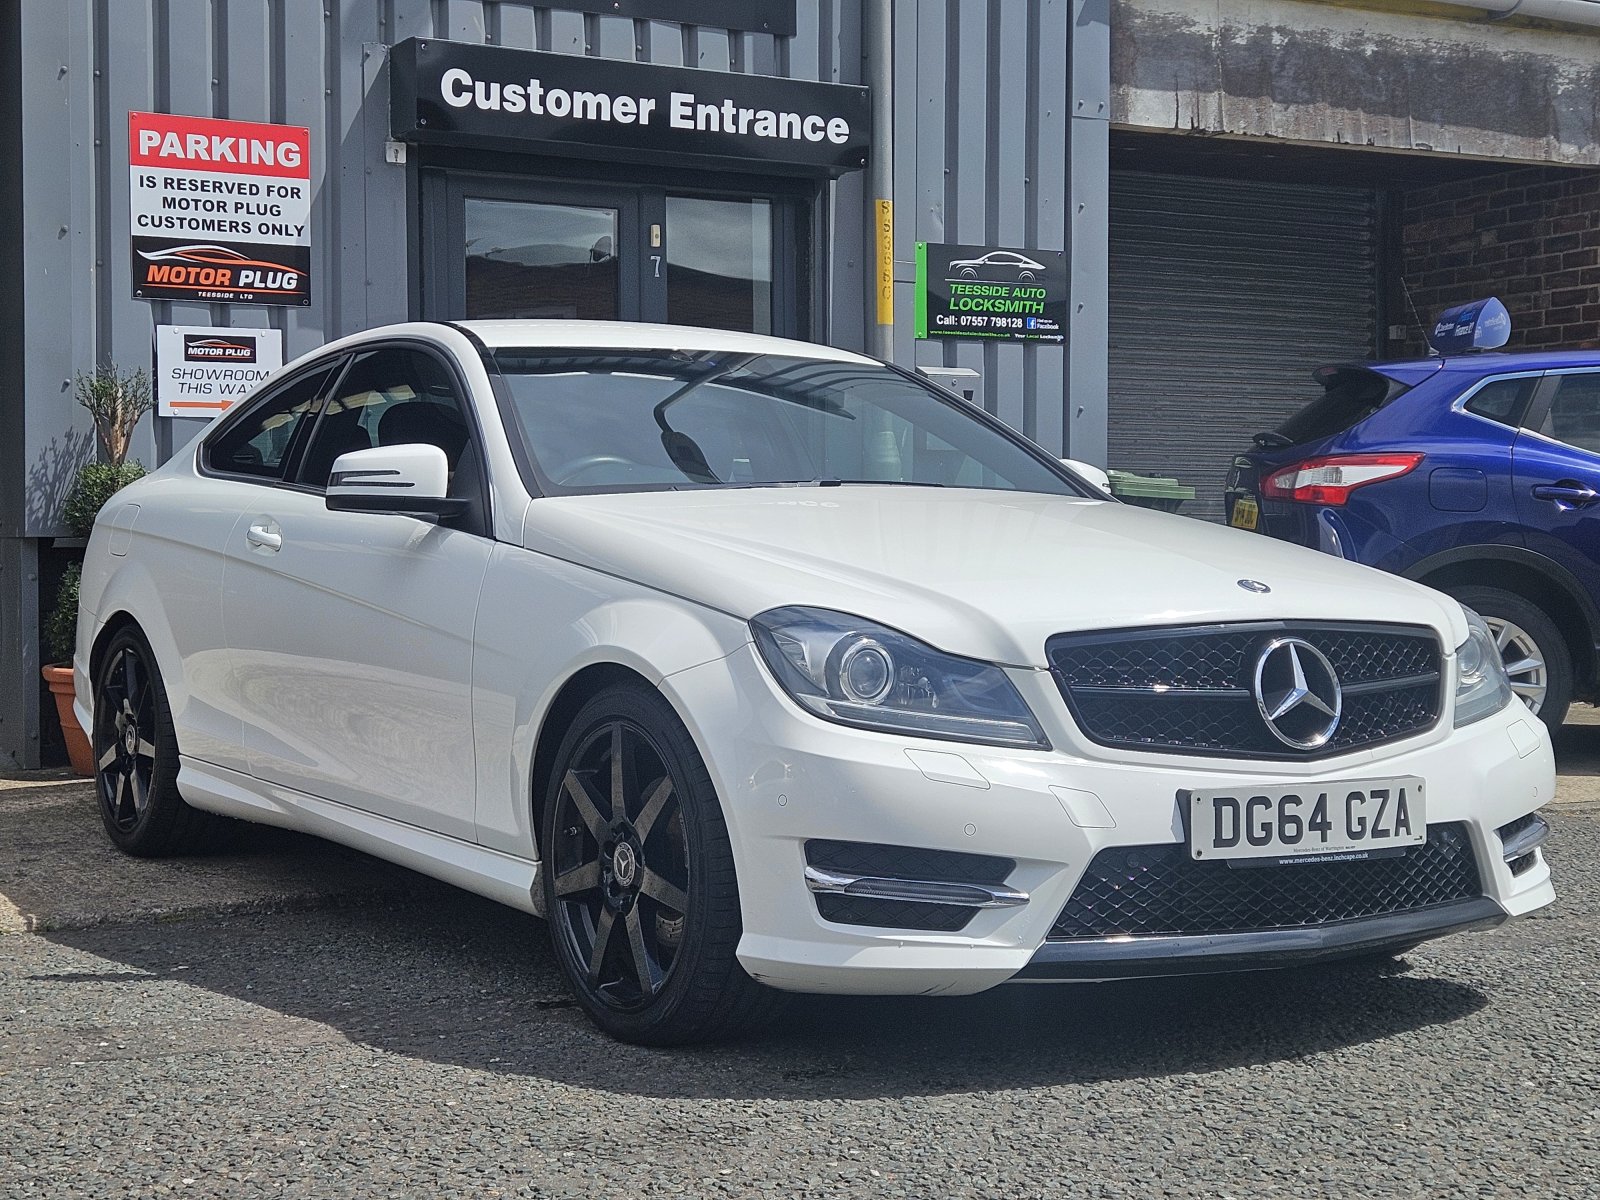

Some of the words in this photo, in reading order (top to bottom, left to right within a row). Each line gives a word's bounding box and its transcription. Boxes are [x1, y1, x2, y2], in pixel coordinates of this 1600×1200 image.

[440, 68, 656, 125] Customer
[669, 91, 850, 144] Entrance
[139, 129, 301, 167] PARKING
[139, 175, 157, 188] IS
[163, 176, 260, 196] RESERVED
[266, 185, 301, 199] FOR
[162, 197, 228, 213] MOTOR
[234, 201, 282, 216] PLUG
[137, 214, 252, 234] CUSTOMERS
[258, 222, 305, 237] ONLY
[650, 255, 661, 277] 7
[147, 265, 232, 285] MOTOR
[238, 270, 298, 289] PLUG
[198, 291, 234, 299] TEESSIDE
[950, 284, 1010, 297] TEESSIDE
[1012, 287, 1046, 298] AUTO
[949, 298, 1044, 313] LOCKSMITH
[936, 314, 958, 326] Call:
[960, 315, 988, 327] 07557
[991, 316, 1023, 328] 798128
[187, 347, 223, 356] MOTOR
[225, 348, 251, 357] PLUG
[171, 367, 270, 382] SHOWROOM
[178, 382, 213, 394] THIS
[1212, 792, 1333, 848] DG64
[1345, 788, 1412, 841] GZA
[1279, 852, 1369, 865] www.mercedes-benz.inchcape.co.uk
